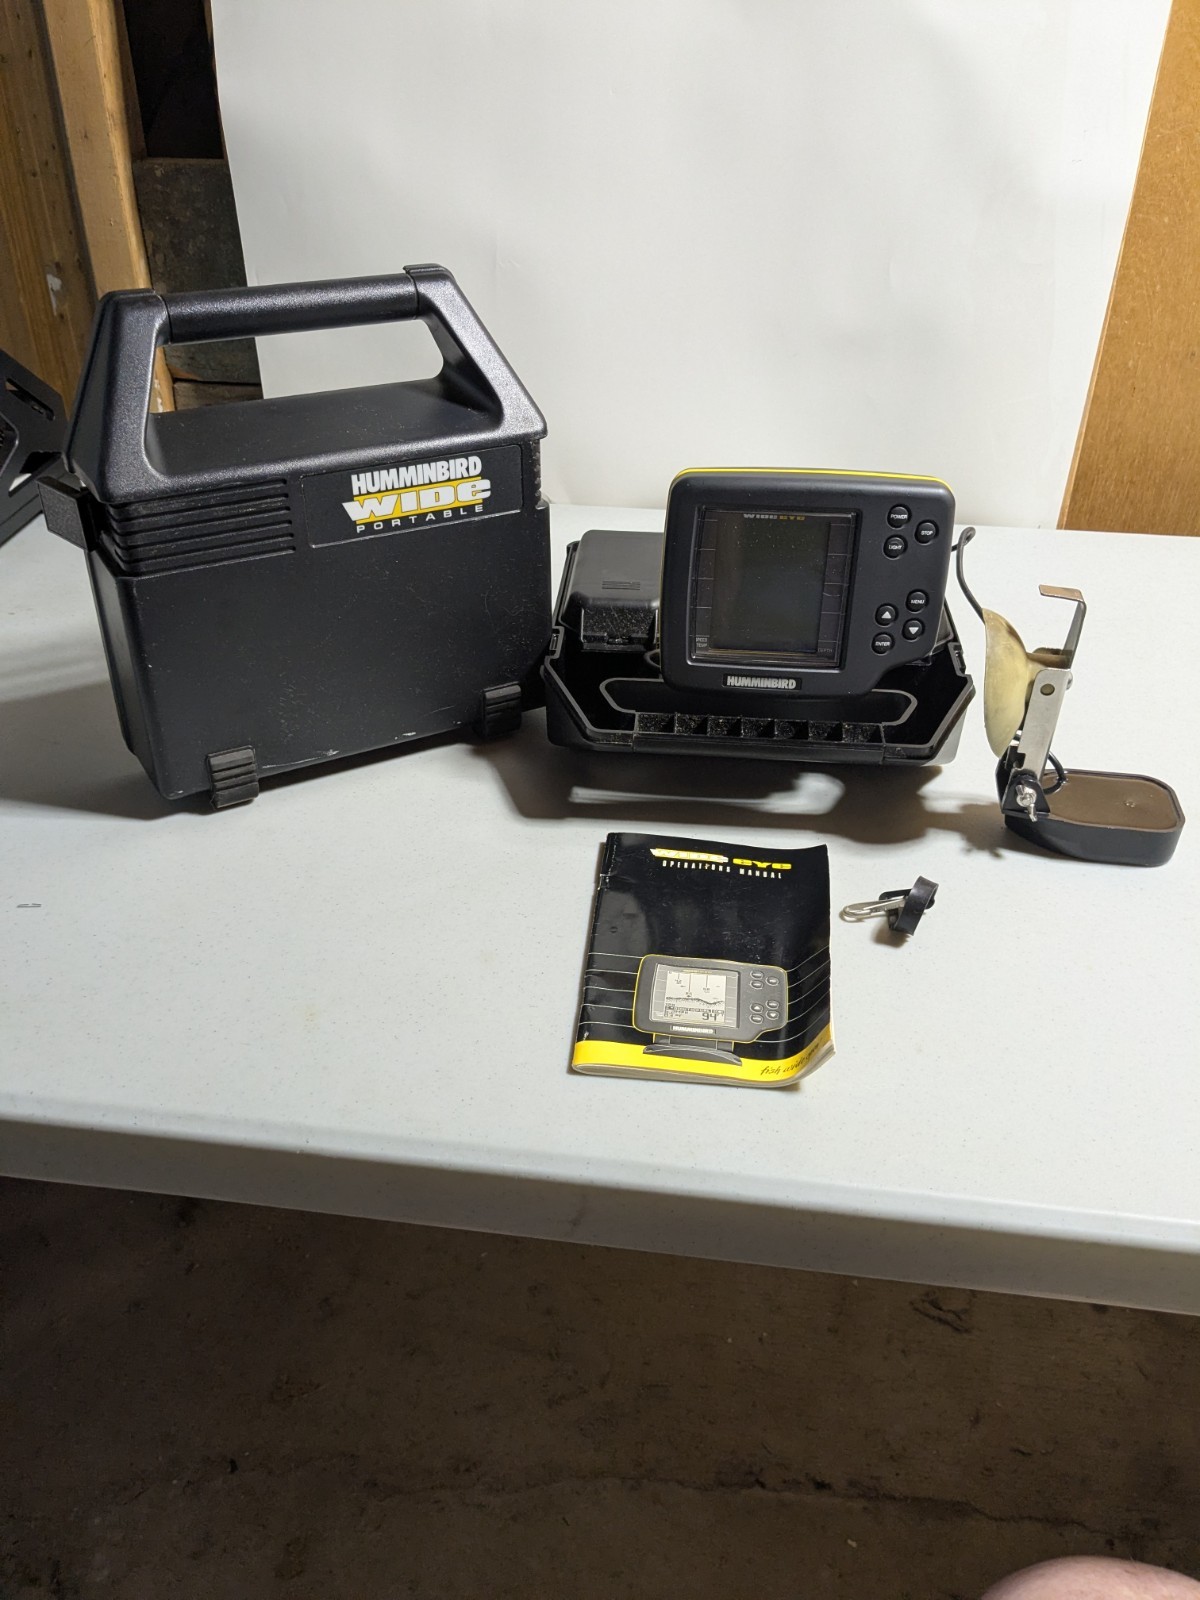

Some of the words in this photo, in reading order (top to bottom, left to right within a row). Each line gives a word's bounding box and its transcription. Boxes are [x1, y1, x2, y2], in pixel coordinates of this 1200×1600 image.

[351, 455, 482, 495] HUMMINBIRD
[356, 504, 484, 533] PORTABLE
[726, 675, 797, 690] HUMMINBIRD
[662, 859, 731, 873] OPERATIONS
[739, 868, 782, 879] MANUAL
